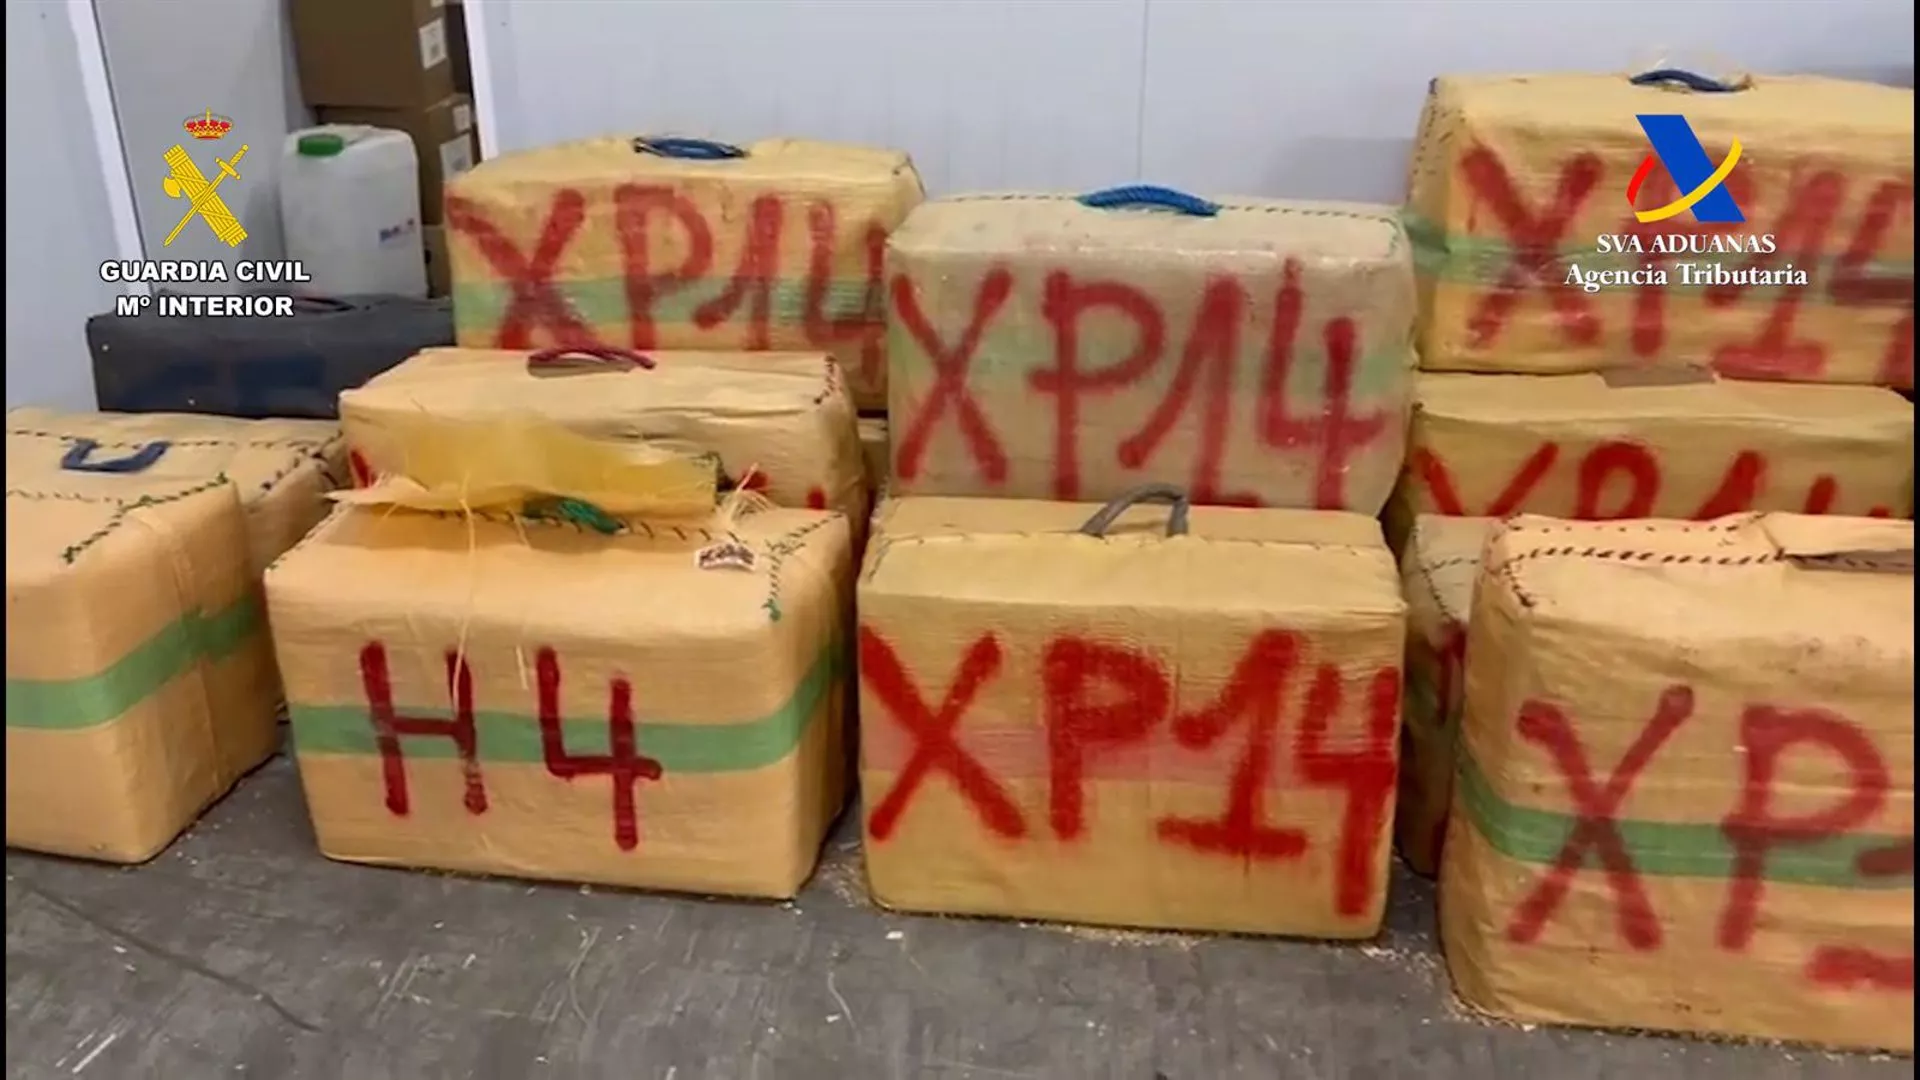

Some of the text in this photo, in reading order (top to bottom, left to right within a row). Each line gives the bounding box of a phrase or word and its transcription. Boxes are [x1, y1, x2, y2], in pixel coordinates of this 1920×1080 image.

[446, 182, 887, 386] XP14
[890, 256, 1386, 509] XP14
[859, 624, 1403, 918] XP14
